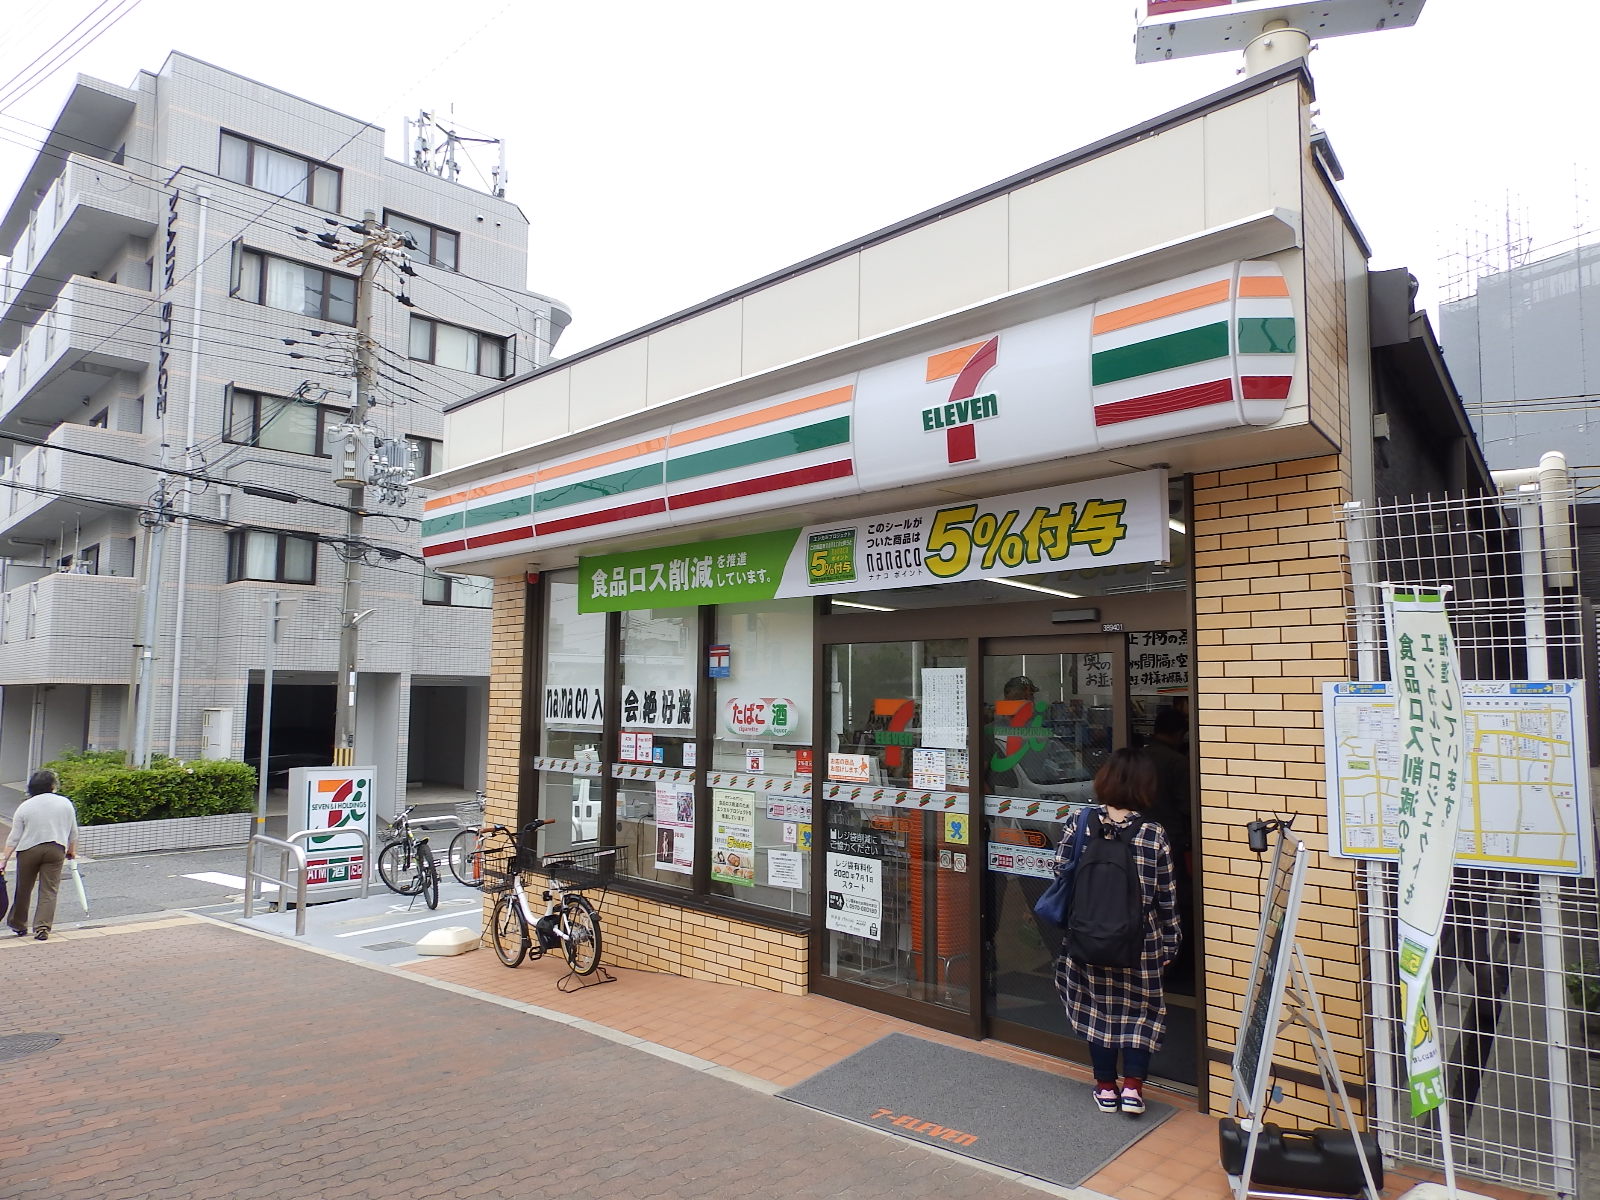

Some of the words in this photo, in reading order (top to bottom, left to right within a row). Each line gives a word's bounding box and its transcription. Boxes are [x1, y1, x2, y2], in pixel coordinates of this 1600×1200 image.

[164, 189, 180, 290] MAIN
[156, 301, 173, 420] STAGE
[868, 517, 923, 535] このシールが
[866, 532, 921, 549] ついた商品は
[924, 499, 1127, 578] 5%付与
[717, 551, 748, 568] を推進
[866, 547, 922, 572] nanaco
[591, 555, 714, 599] 食品ロス削減
[717, 568, 771, 588] しています。
[732, 703, 766, 725] たばこ
[771, 703, 788, 726] 酒
[312, 803, 330, 812] SEVEN
[338, 801, 367, 810] HOLDINGS
[833, 868, 874, 883] 2020年7月1日
[835, 860, 873, 874] レジ袋有料化
[842, 880, 866, 892] スタート
